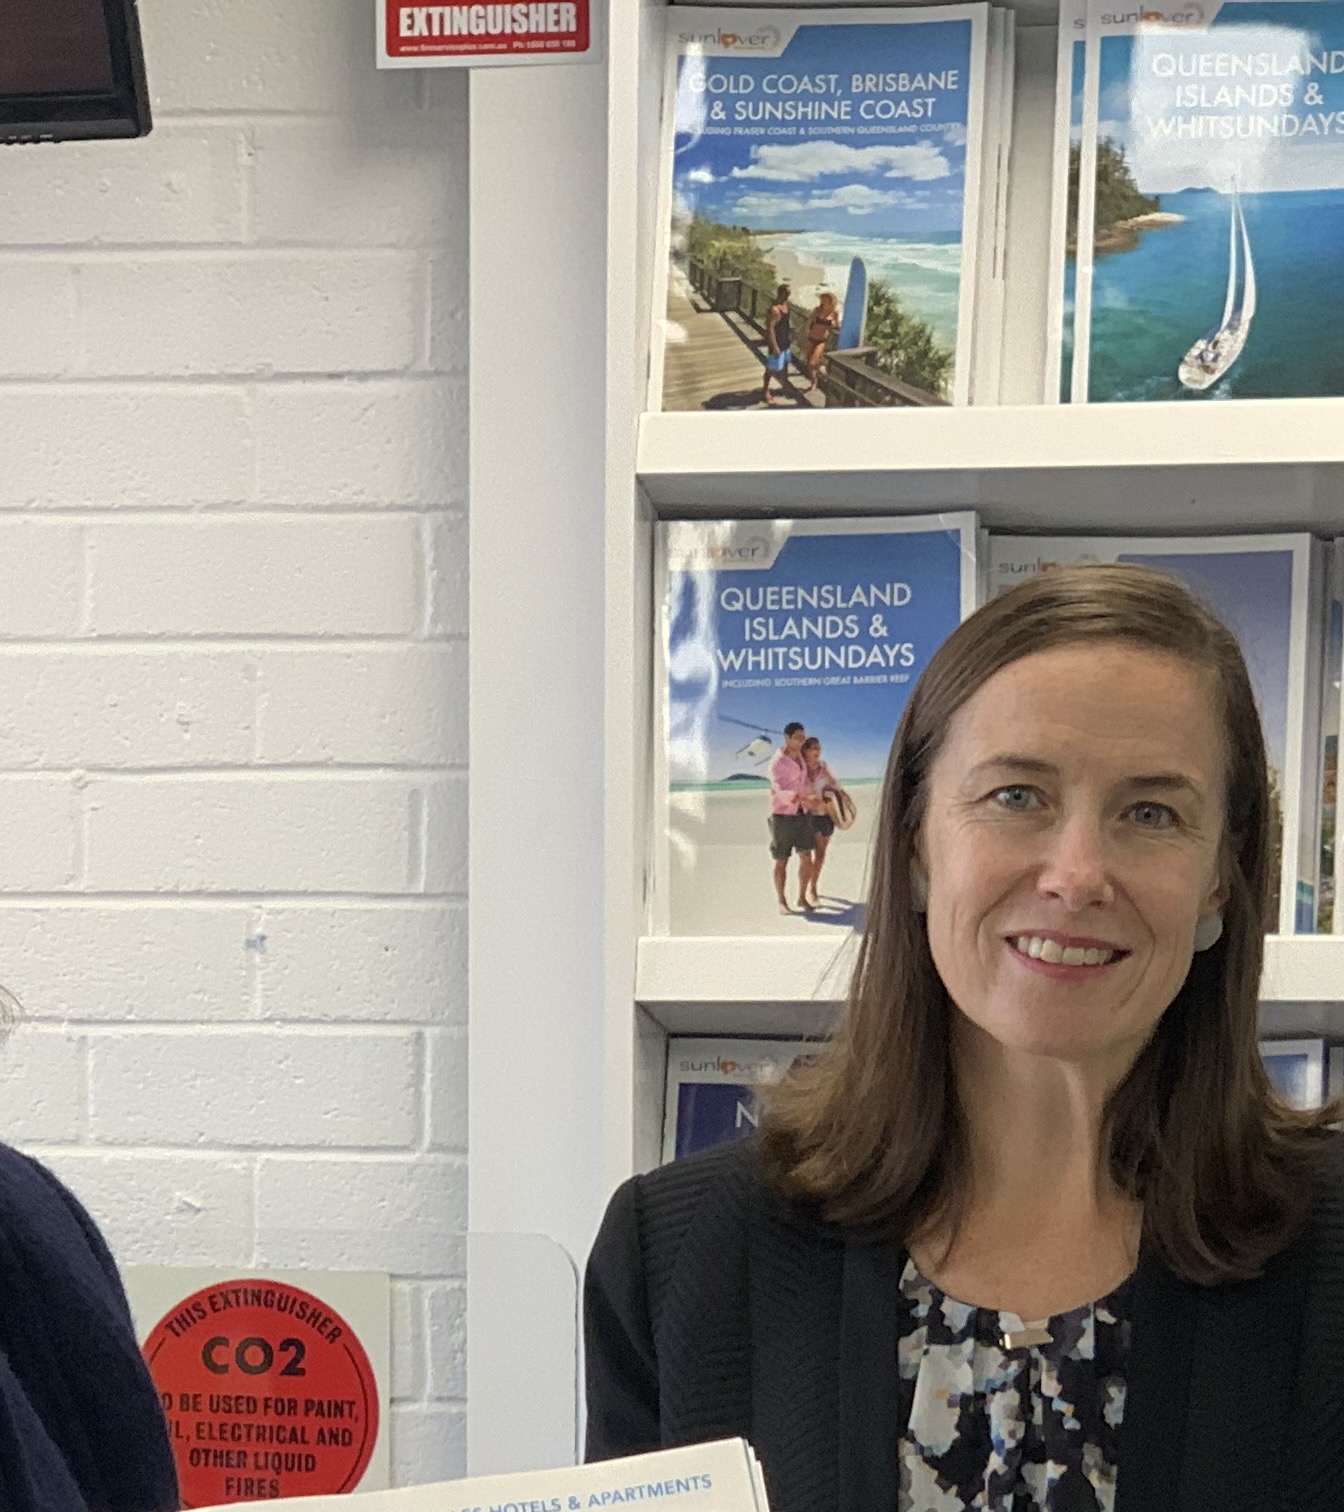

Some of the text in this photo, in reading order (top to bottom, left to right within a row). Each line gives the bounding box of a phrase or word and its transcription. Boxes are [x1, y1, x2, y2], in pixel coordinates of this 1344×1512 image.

[399, 2, 576, 37] EXTINGUISHER
[690, 70, 959, 96] GOLD COAST, BRISBANE
[1175, 82, 1324, 107] ISLANDS &
[710, 98, 936, 120] & SUNSHINE COAST
[720, 583, 912, 611] QUEENSLAND
[744, 614, 888, 641] ISLANDS &
[717, 643, 915, 671] WHITSUNDAYS
[165, 1288, 342, 1344] THIS EXTINGUISHER
[201, 1335, 306, 1377] CO2
[161, 1393, 358, 1423] O BE USED FOR PAINT,
[168, 1419, 353, 1447] IL, ELECTRICAL AND
[189, 1447, 318, 1475] OTHER LIQUID
[225, 1477, 280, 1498] FIRES
[568, 1495, 582, 1511] &
[587, 1474, 713, 1509] APARTMENTS
